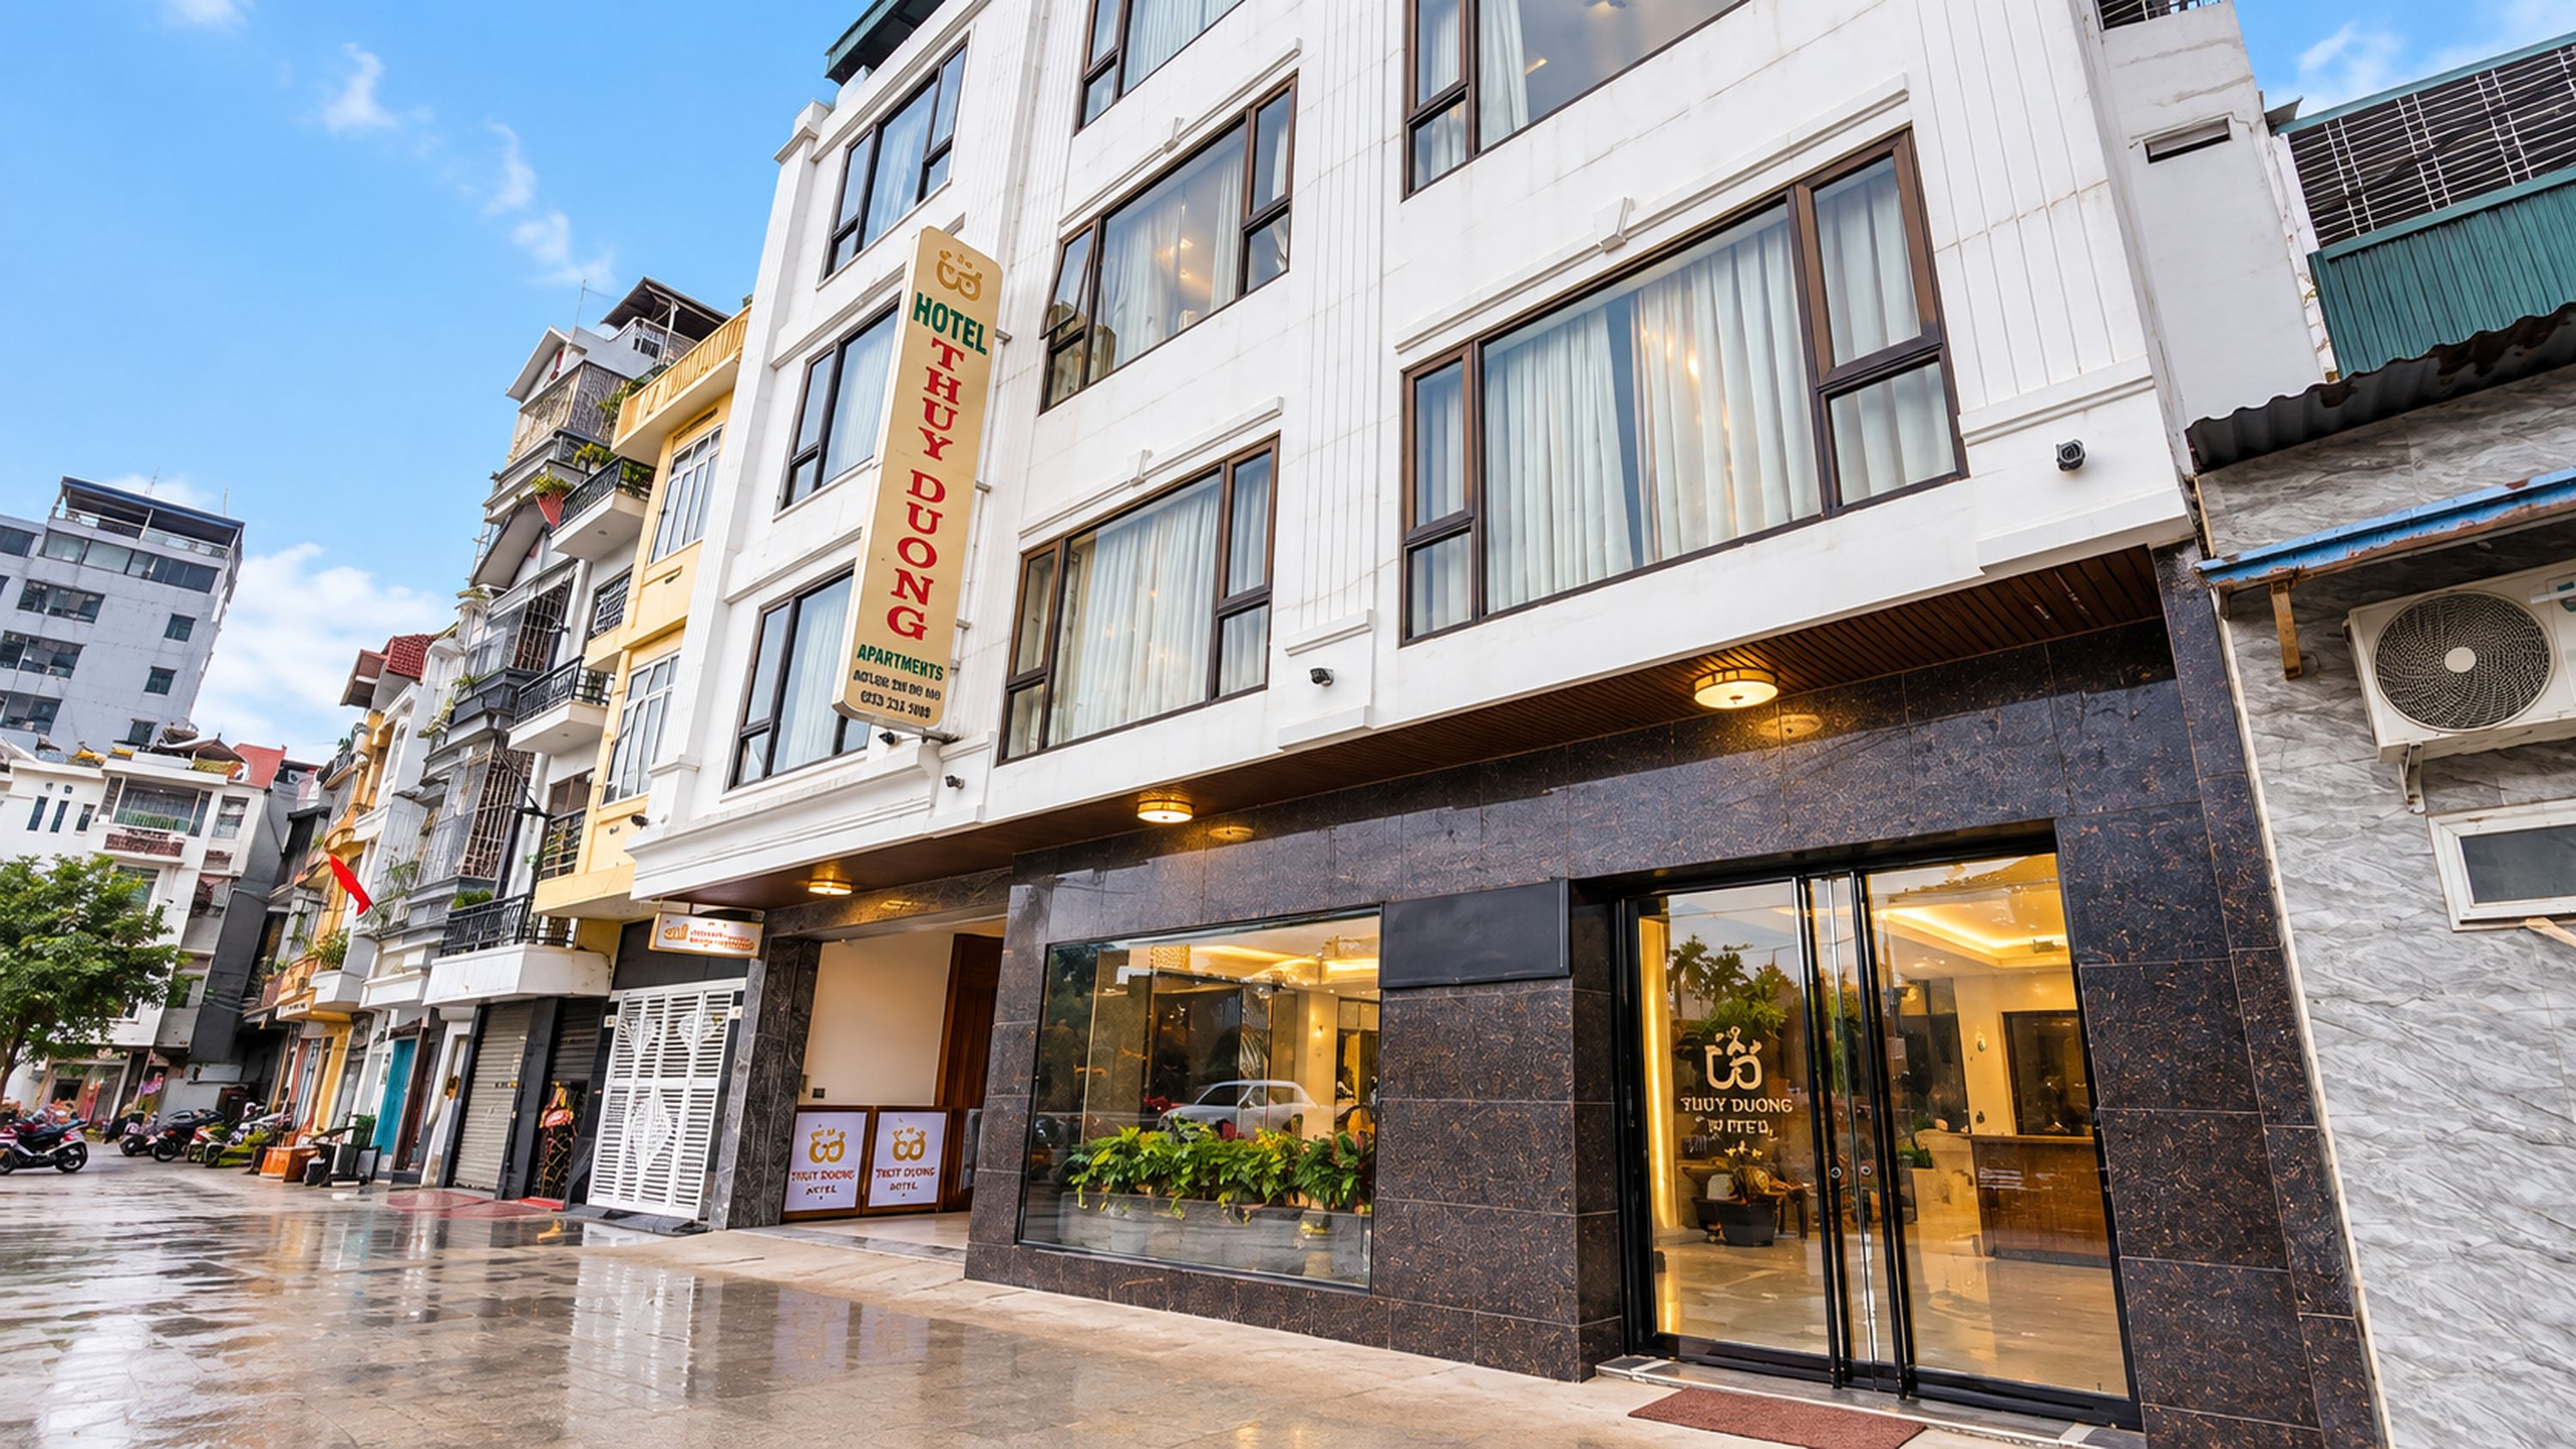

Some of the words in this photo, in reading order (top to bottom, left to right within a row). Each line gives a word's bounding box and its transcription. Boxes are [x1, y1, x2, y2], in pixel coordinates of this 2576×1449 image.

[913, 292, 987, 355] HOTEL
[918, 336, 965, 461] THUY
[887, 469, 946, 641] DUONG
[1729, 1097, 1793, 1113] DUONG
